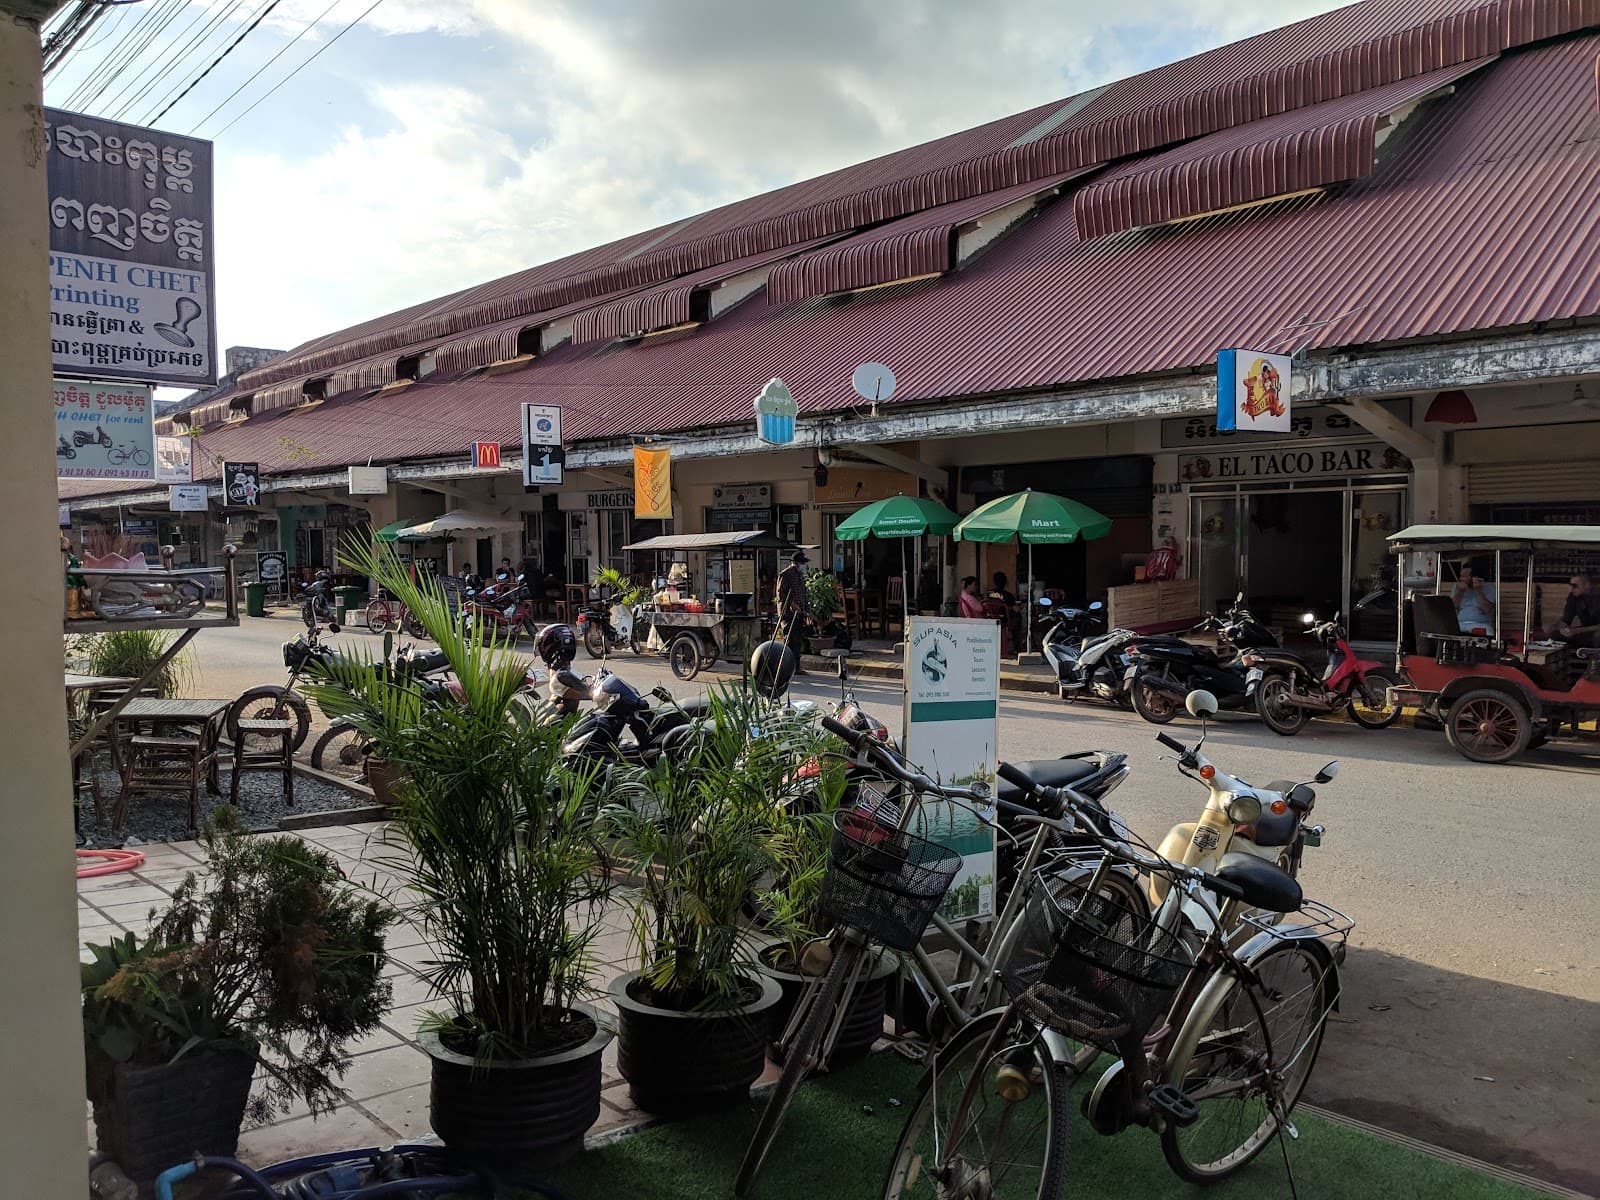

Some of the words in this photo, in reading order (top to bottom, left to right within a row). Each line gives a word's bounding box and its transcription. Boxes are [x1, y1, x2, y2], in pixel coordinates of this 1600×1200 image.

[127, 267, 200, 294] CHET
[128, 319, 145, 334] &
[106, 413, 120, 424] for
[124, 415, 144, 424] rent
[1218, 456, 1246, 477] EL
[1251, 452, 1314, 475] TACO
[1320, 449, 1374, 473] BAR
[588, 492, 635, 508] BURGERS
[1031, 519, 1060, 527] Mart
